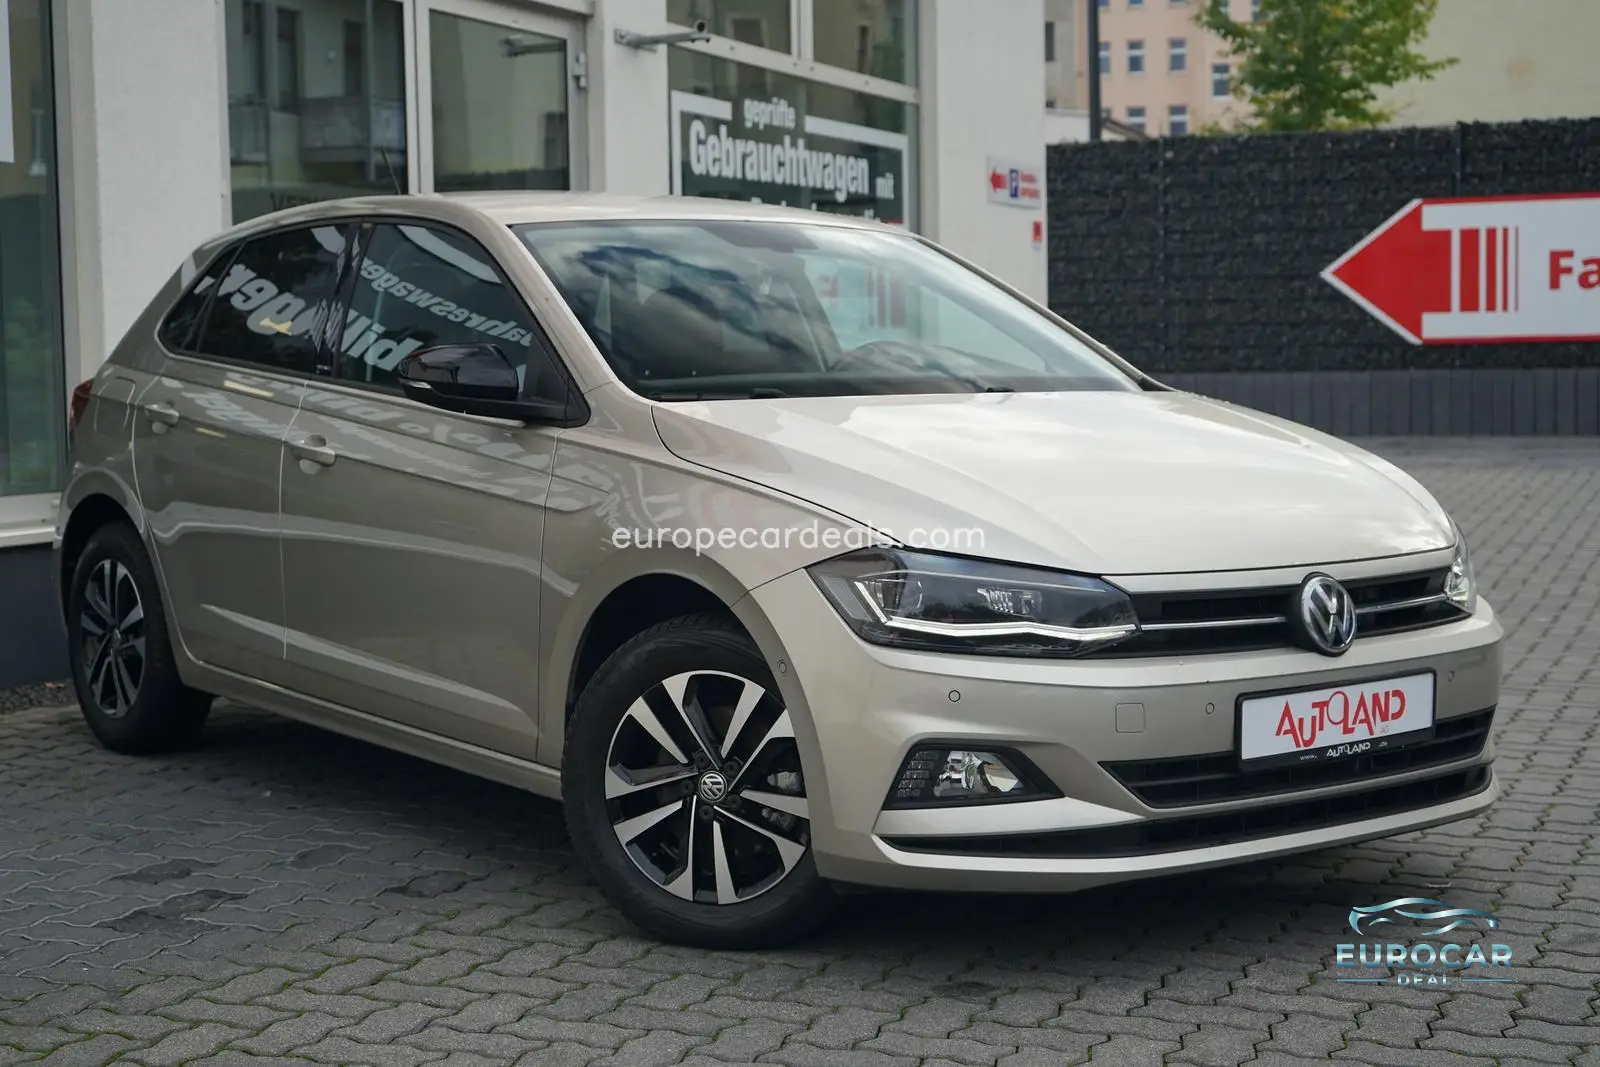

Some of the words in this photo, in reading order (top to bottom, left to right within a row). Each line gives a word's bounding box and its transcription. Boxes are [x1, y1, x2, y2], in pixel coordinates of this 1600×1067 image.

[743, 97, 796, 130] geprüfte
[688, 119, 870, 203] Gebrauchtwagen
[875, 172, 895, 200] mit
[1275, 689, 1407, 749] AUTOLAND
[1326, 740, 1371, 758] AUTOLAND
